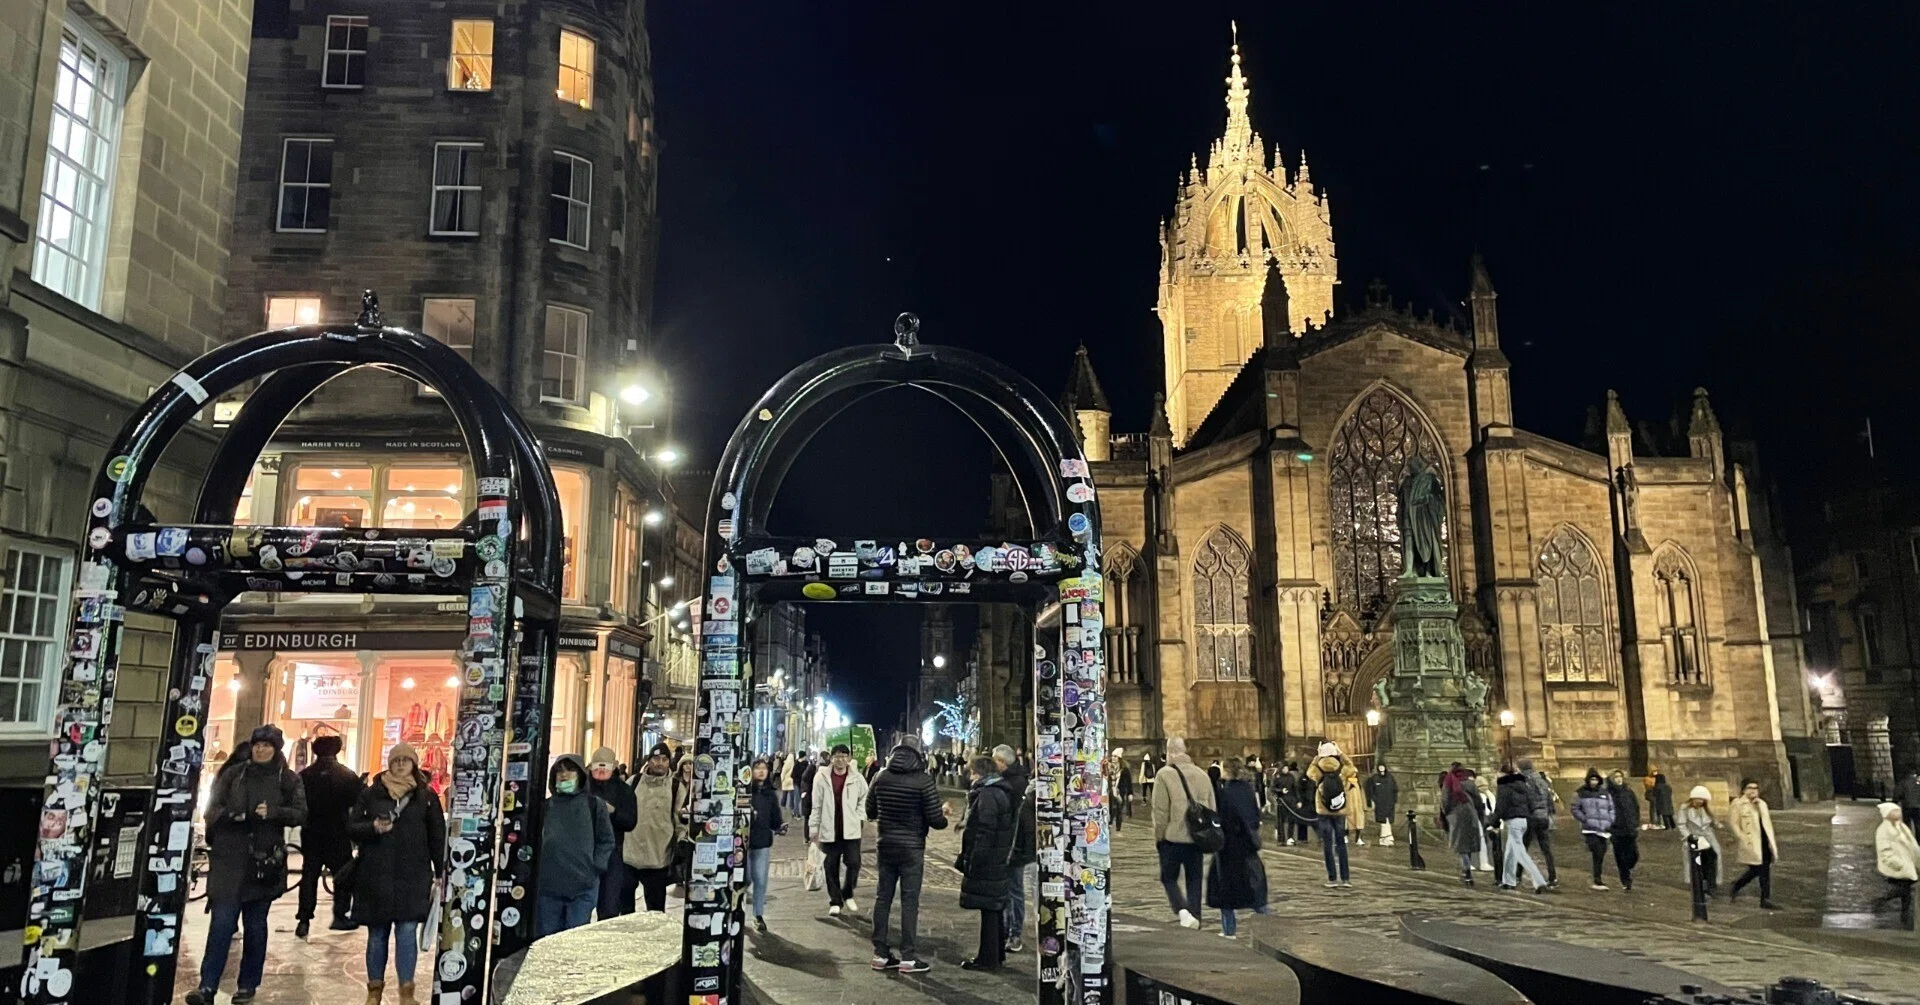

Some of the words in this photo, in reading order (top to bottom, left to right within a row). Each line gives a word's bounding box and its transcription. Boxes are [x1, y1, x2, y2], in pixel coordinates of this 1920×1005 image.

[547, 446, 583, 456] CASHMERE
[244, 634, 357, 648] EDINBURGH
[559, 637, 596, 647] DINBURGH
